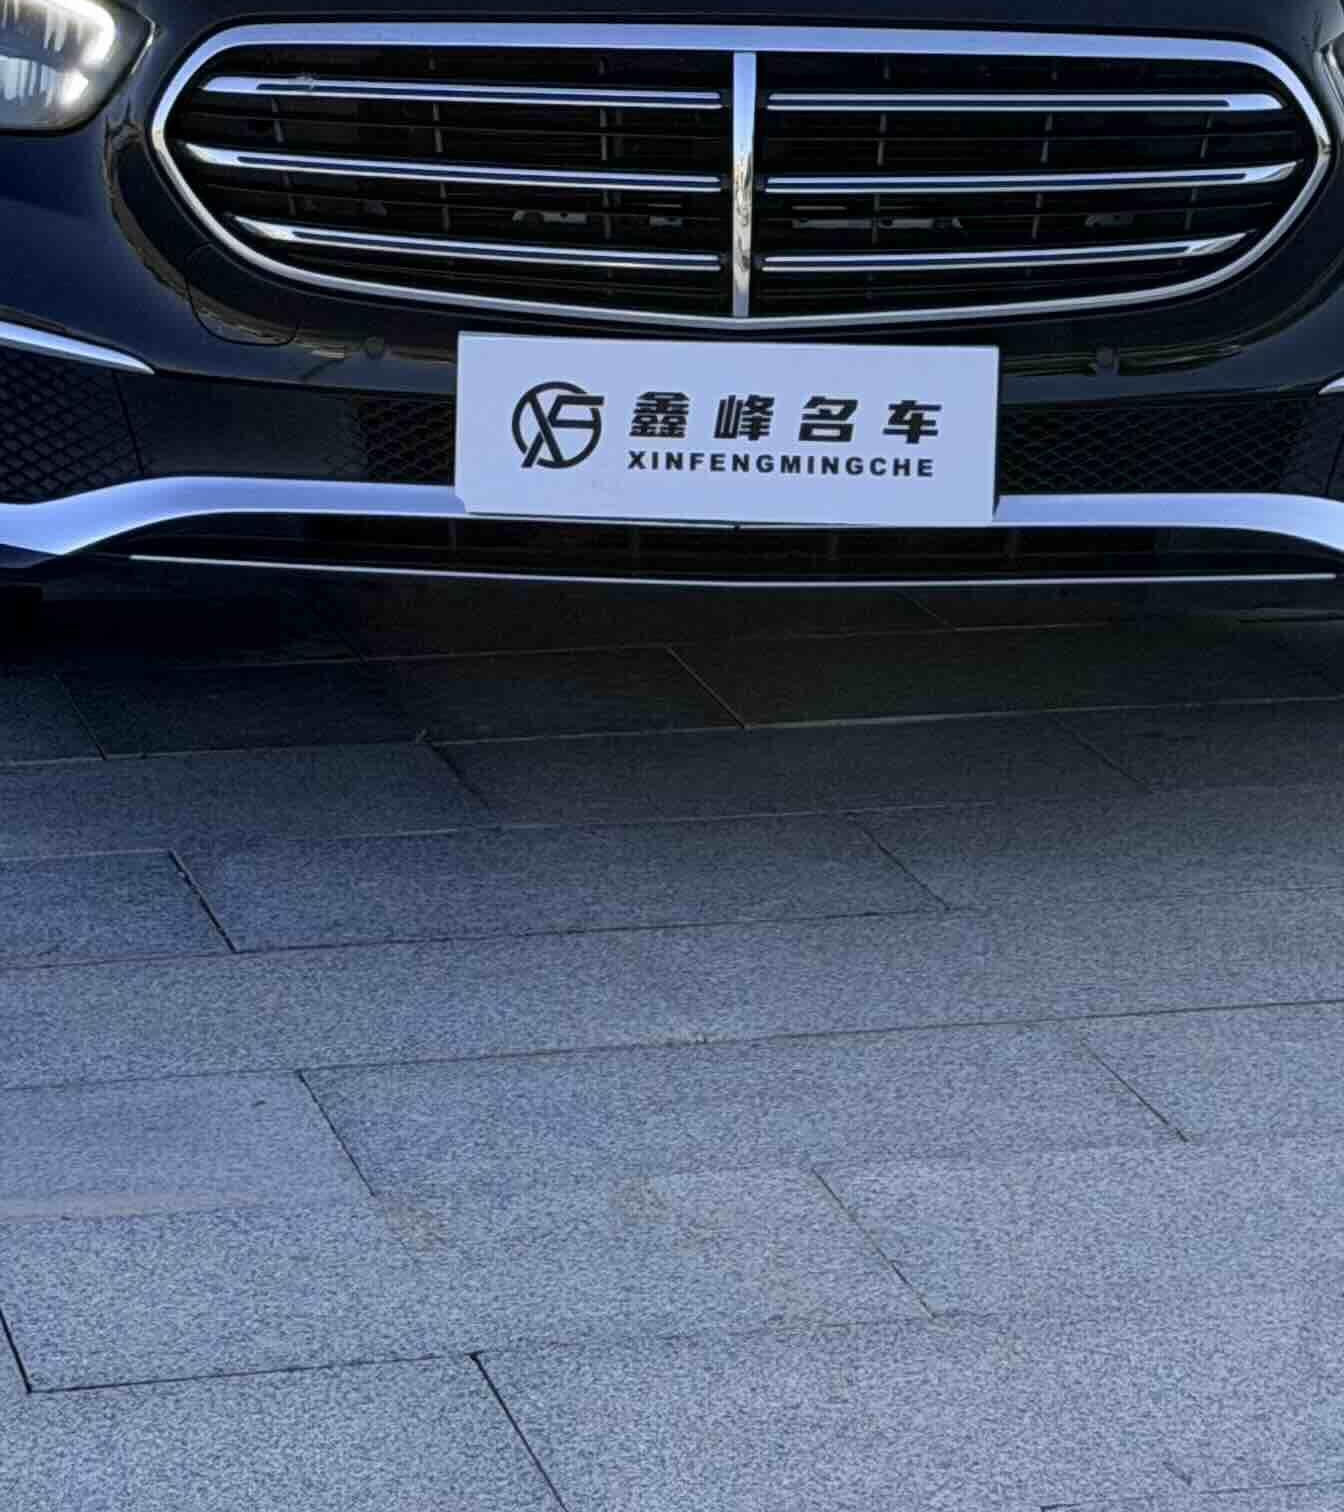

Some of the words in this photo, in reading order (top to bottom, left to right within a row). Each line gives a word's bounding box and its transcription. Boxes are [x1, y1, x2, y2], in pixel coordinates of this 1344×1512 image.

[629, 391, 942, 445] 鑫峰名车
[628, 450, 935, 478] XINFENGMINGCHE
